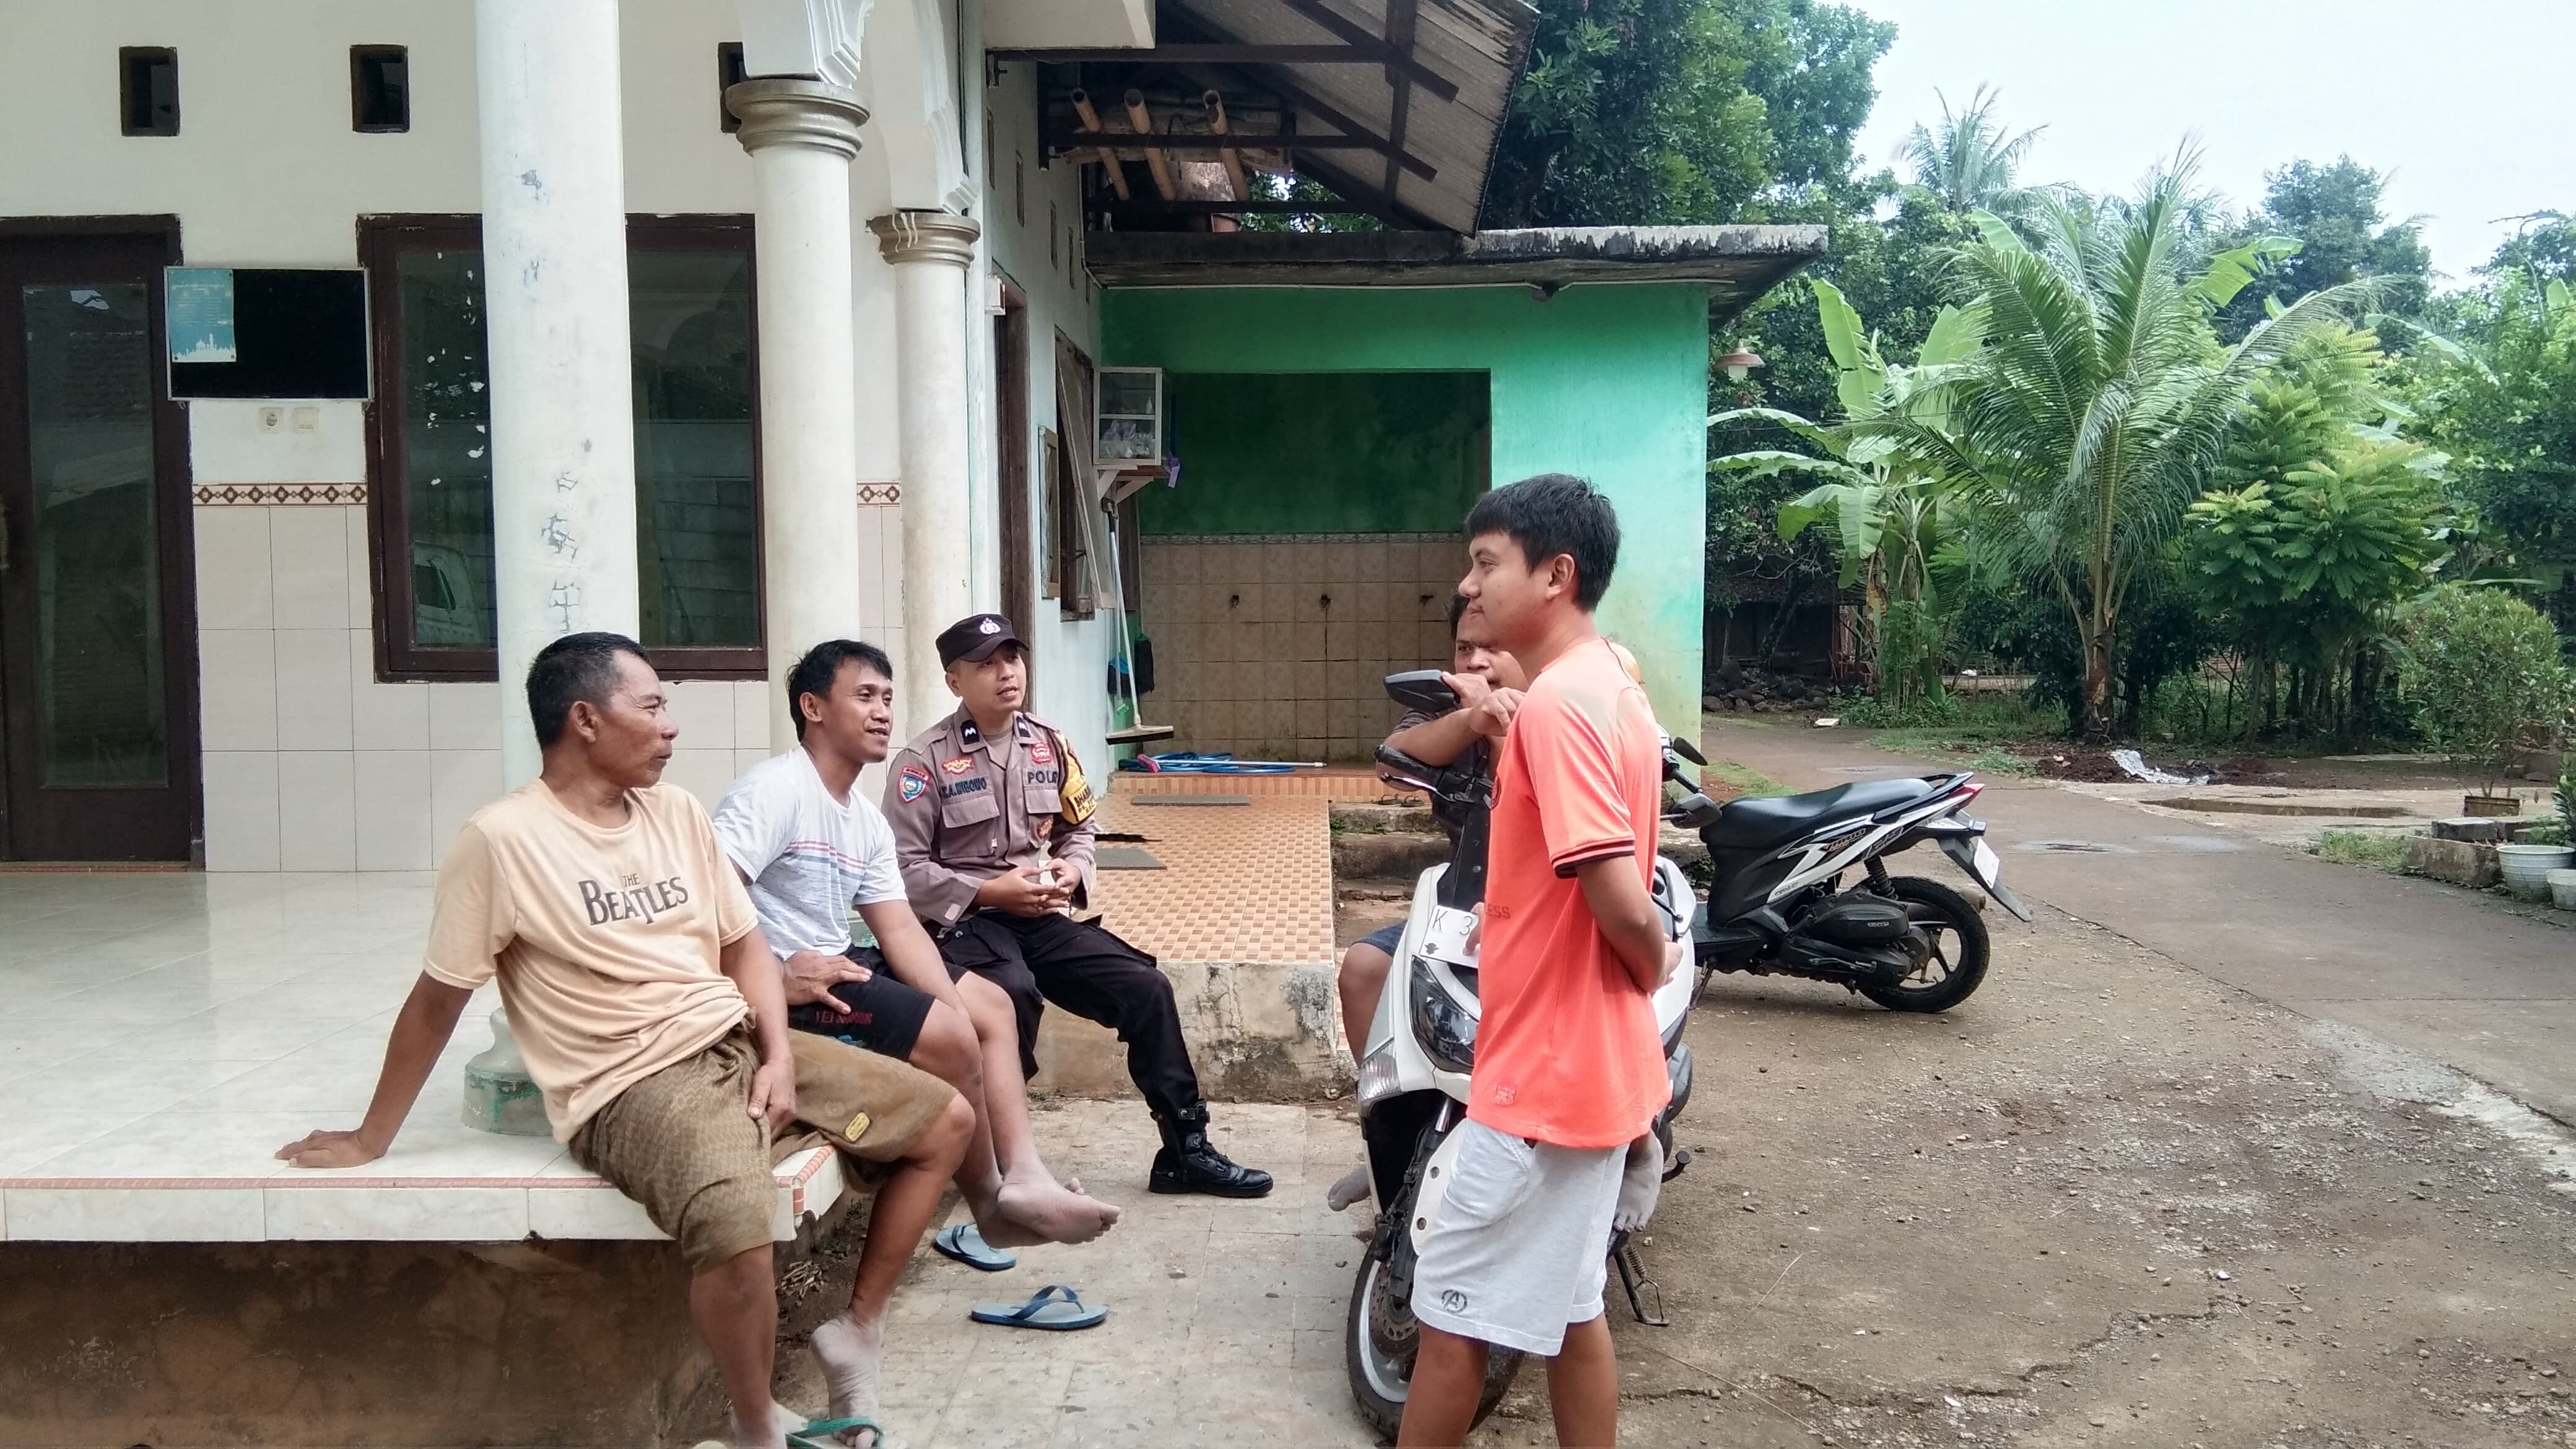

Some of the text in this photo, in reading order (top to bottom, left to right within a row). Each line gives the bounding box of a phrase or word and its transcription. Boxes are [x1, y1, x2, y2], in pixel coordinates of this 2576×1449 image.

[1028, 770, 1058, 784] POLR
[622, 873, 640, 887] THE
[578, 876, 689, 926] BEATLES
[1433, 909, 1473, 936] K 3
